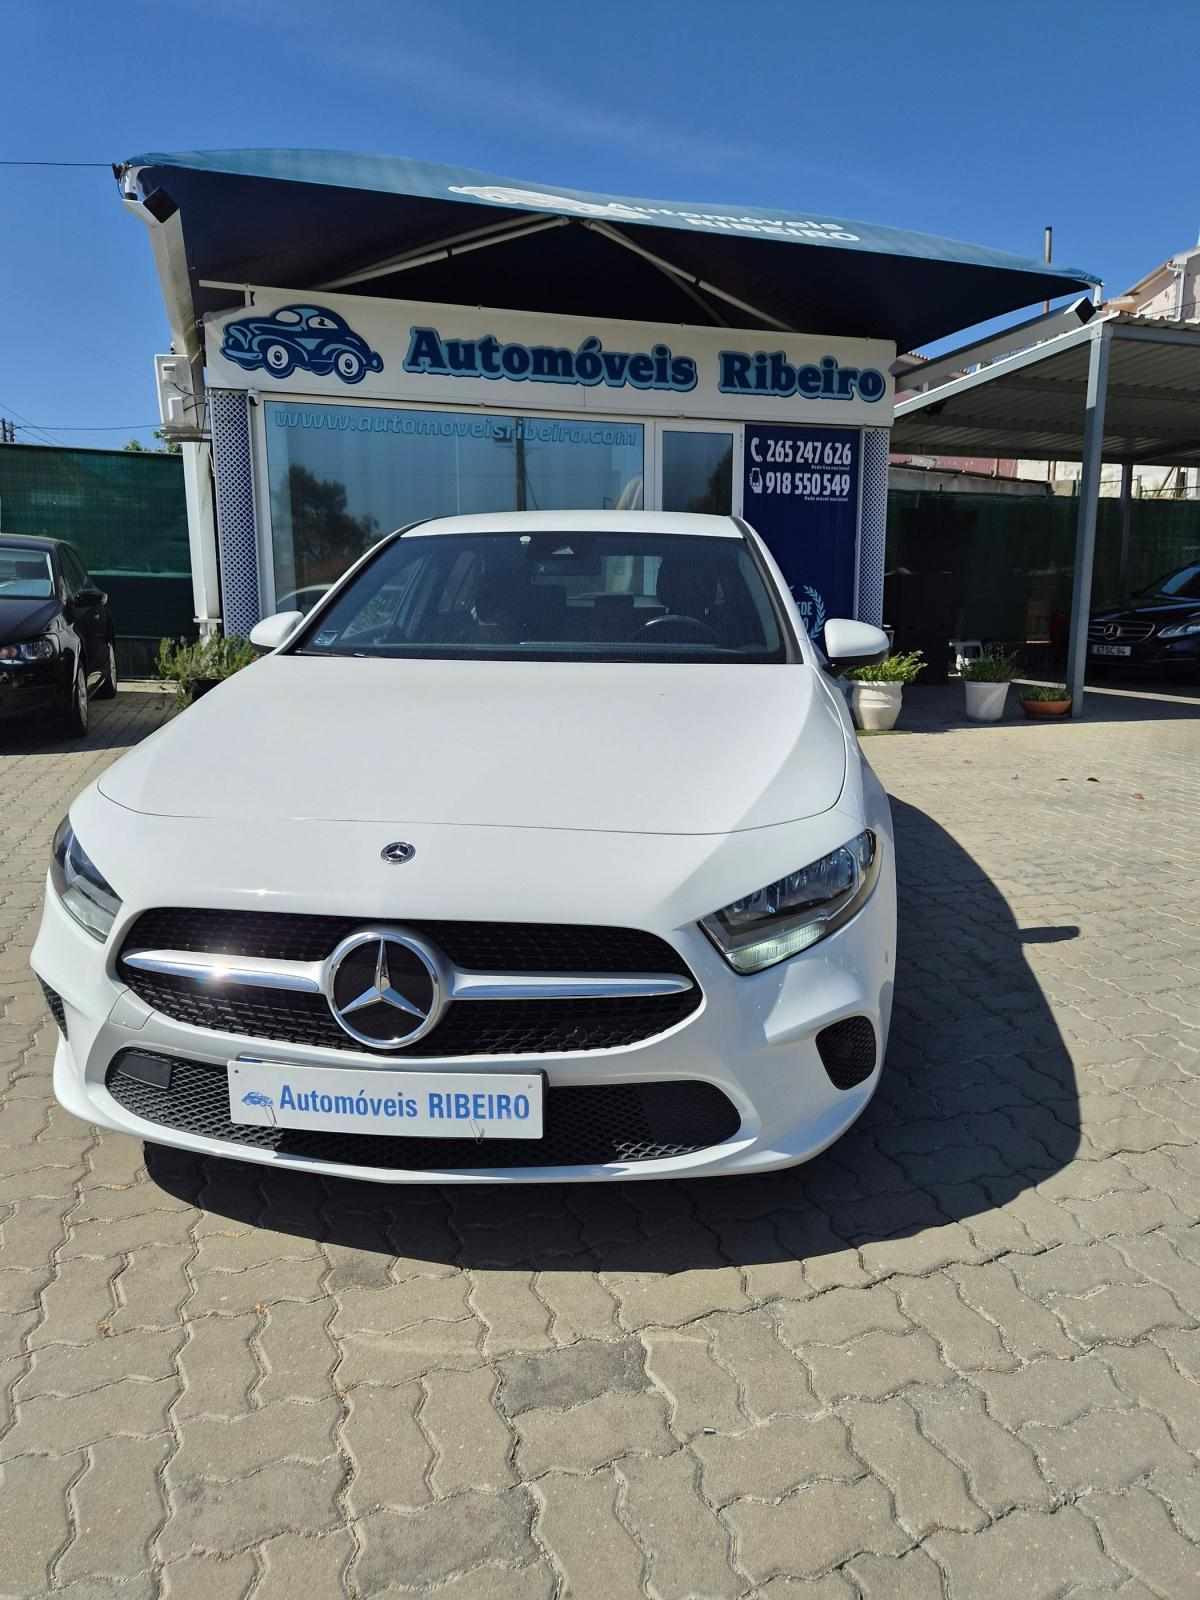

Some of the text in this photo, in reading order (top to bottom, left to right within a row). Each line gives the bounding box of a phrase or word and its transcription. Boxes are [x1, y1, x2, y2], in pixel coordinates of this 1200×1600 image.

[686, 218, 860, 241] RIBEIRO
[403, 326, 886, 403] Automóveis Ribeiro
[766, 439, 852, 465] 265 247 626
[765, 471, 850, 496] 918 550 549
[279, 1083, 530, 1121] Automóveis RIBEIRO
